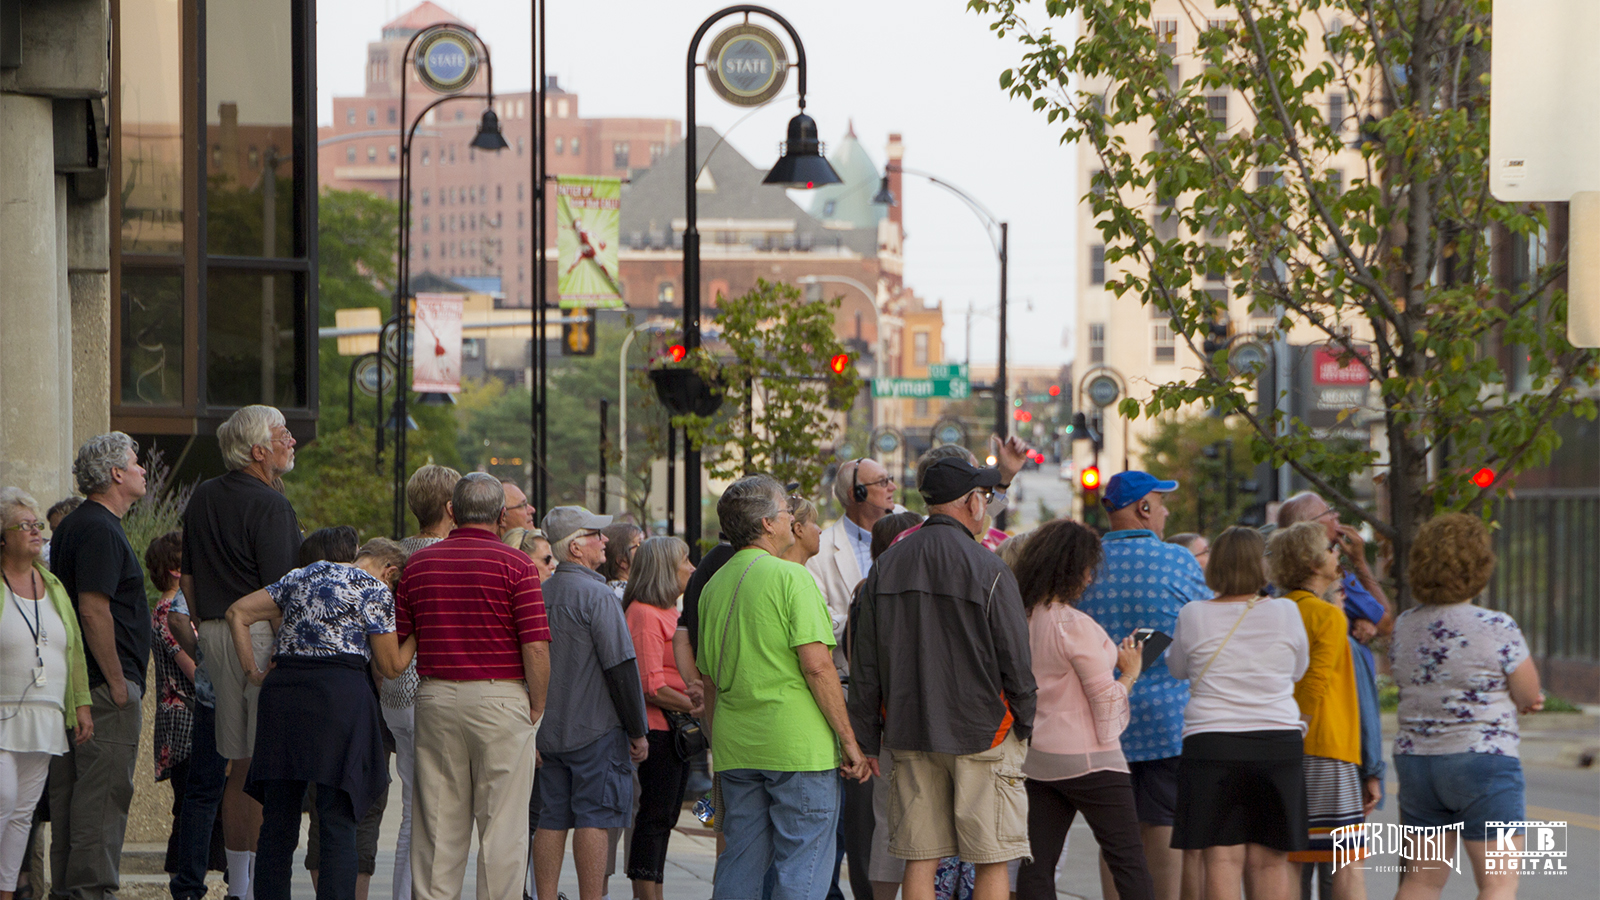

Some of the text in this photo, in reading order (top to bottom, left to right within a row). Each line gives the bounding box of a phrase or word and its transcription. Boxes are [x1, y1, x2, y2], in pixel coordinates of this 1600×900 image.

[429, 53, 464, 68] STATE
[706, 59, 718, 72] W
[726, 58, 768, 74] STATE
[875, 378, 968, 399] Wyman St
